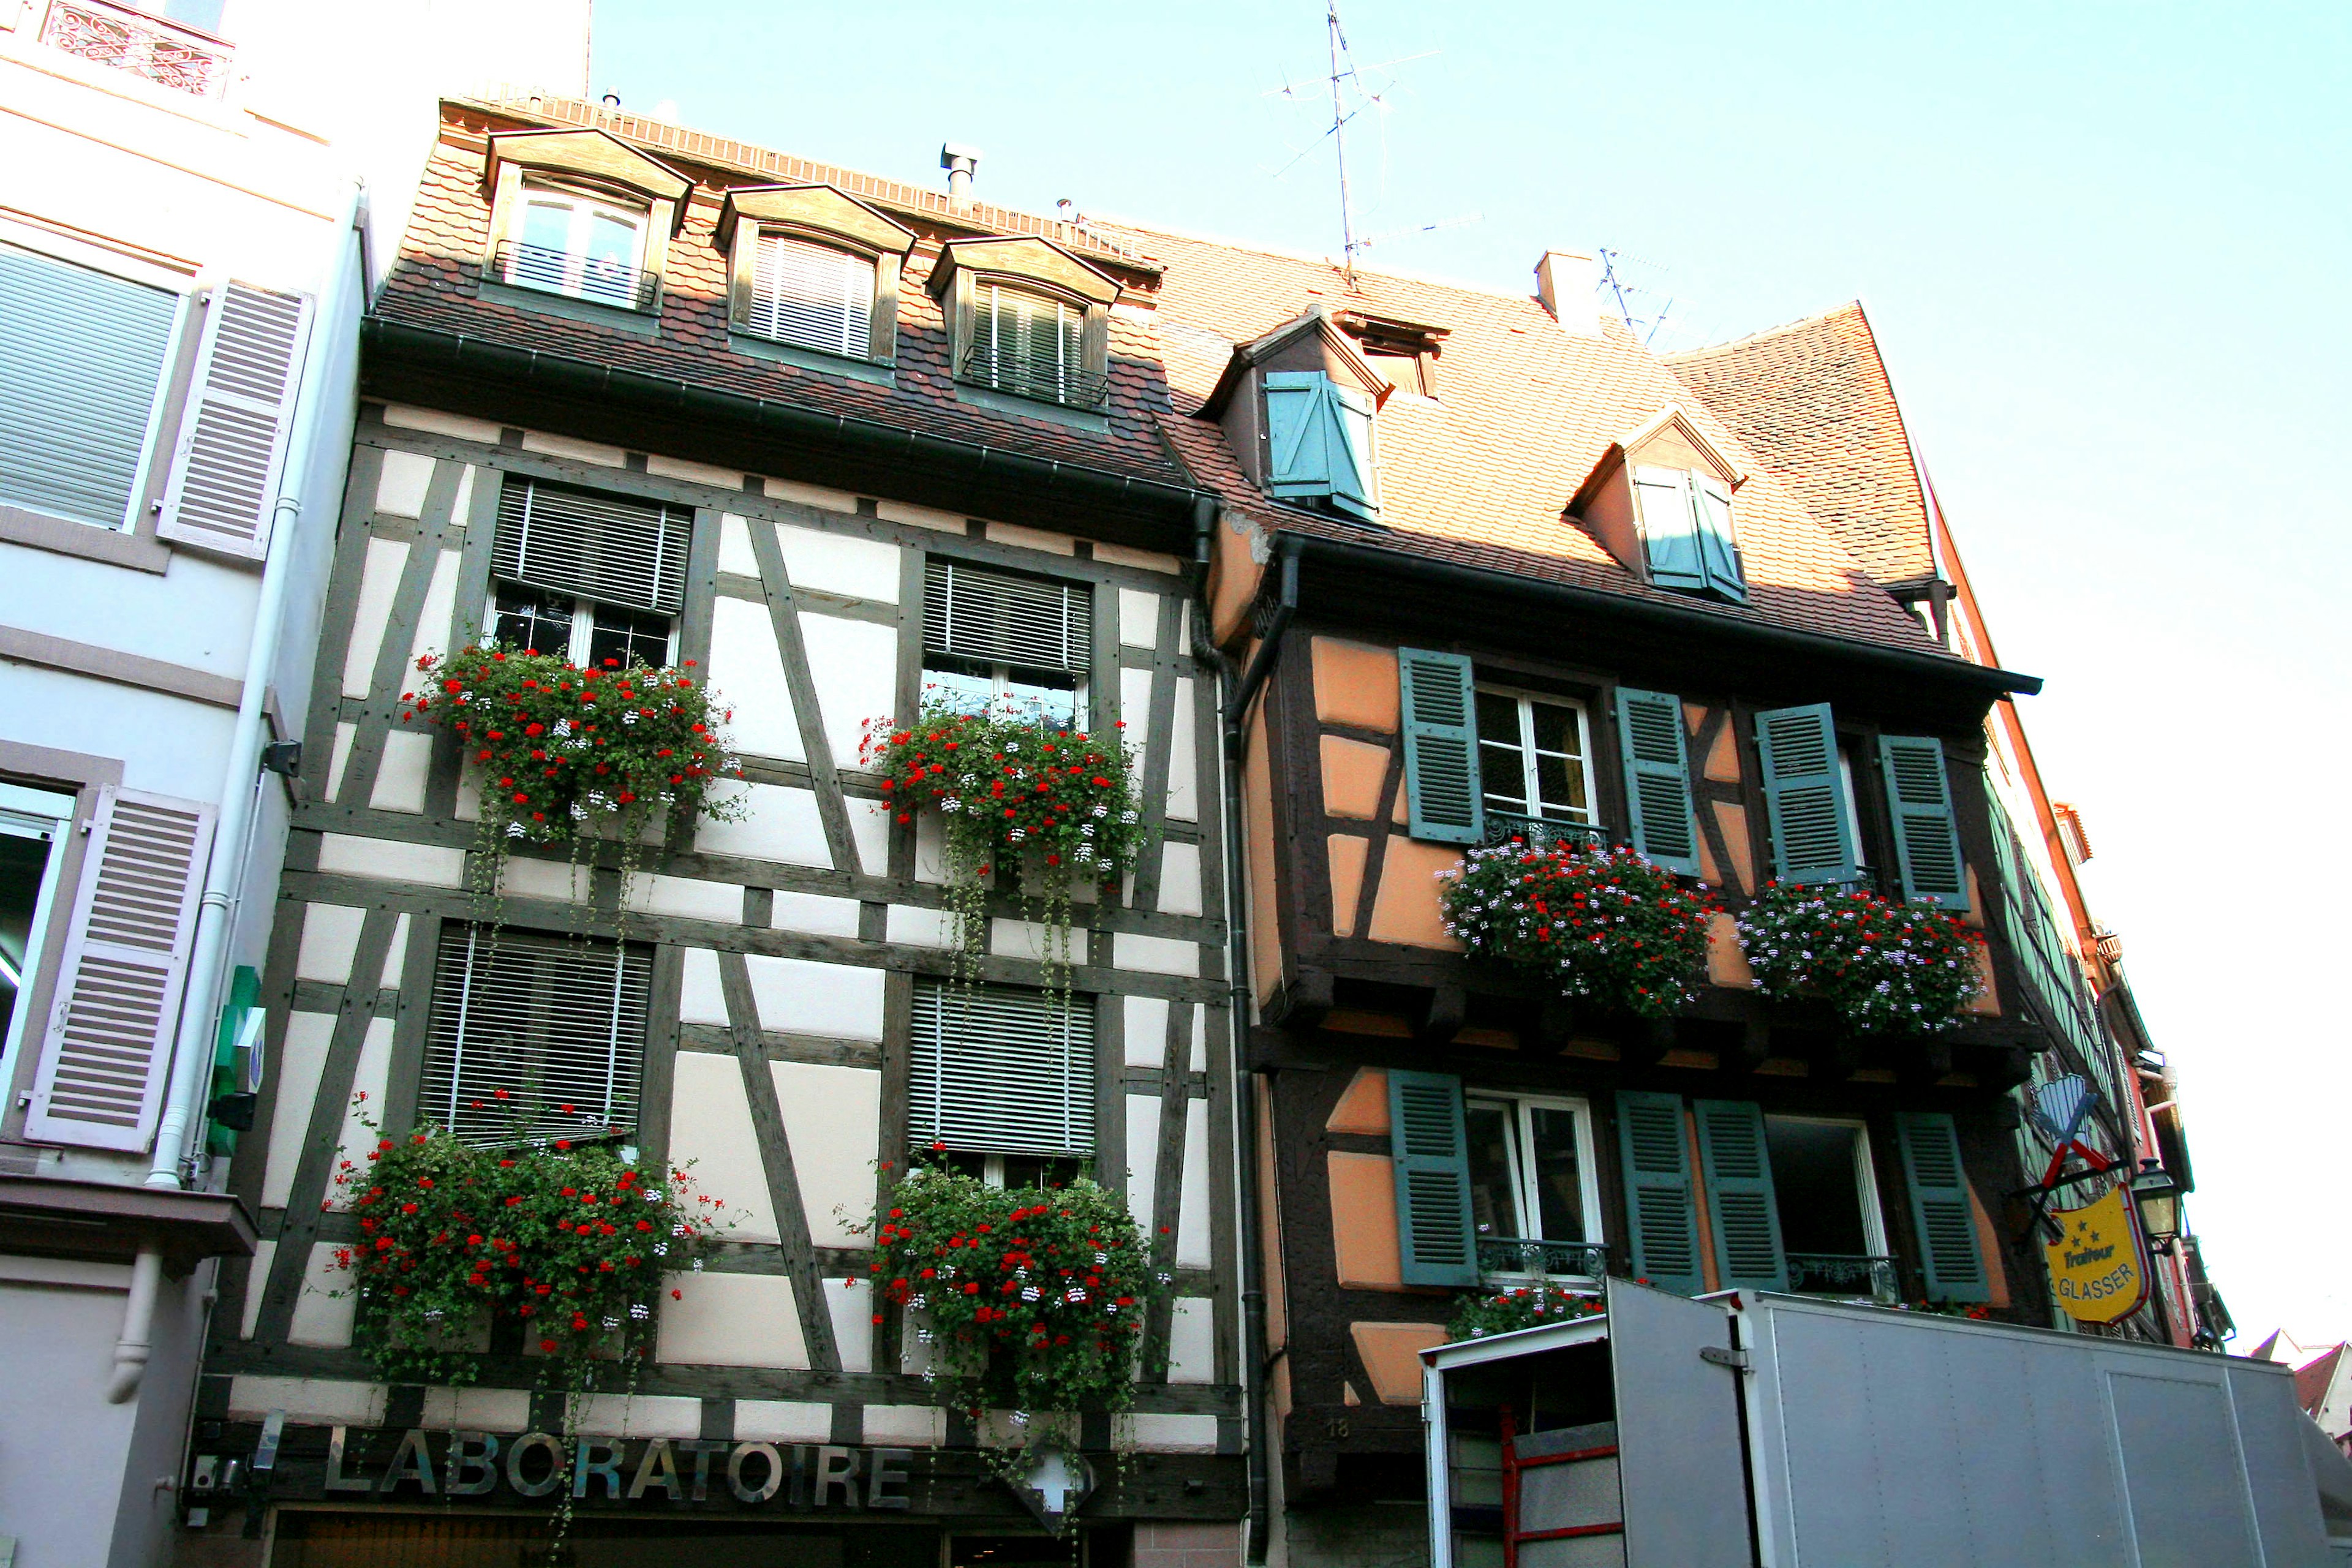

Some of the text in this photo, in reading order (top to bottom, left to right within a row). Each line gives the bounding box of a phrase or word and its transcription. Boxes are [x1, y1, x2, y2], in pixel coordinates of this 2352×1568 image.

[2064, 1245, 2114, 1268] Traiteur
[2059, 1263, 2134, 1300] GLASSER
[325, 1426, 913, 1509] LABORATOIRE
